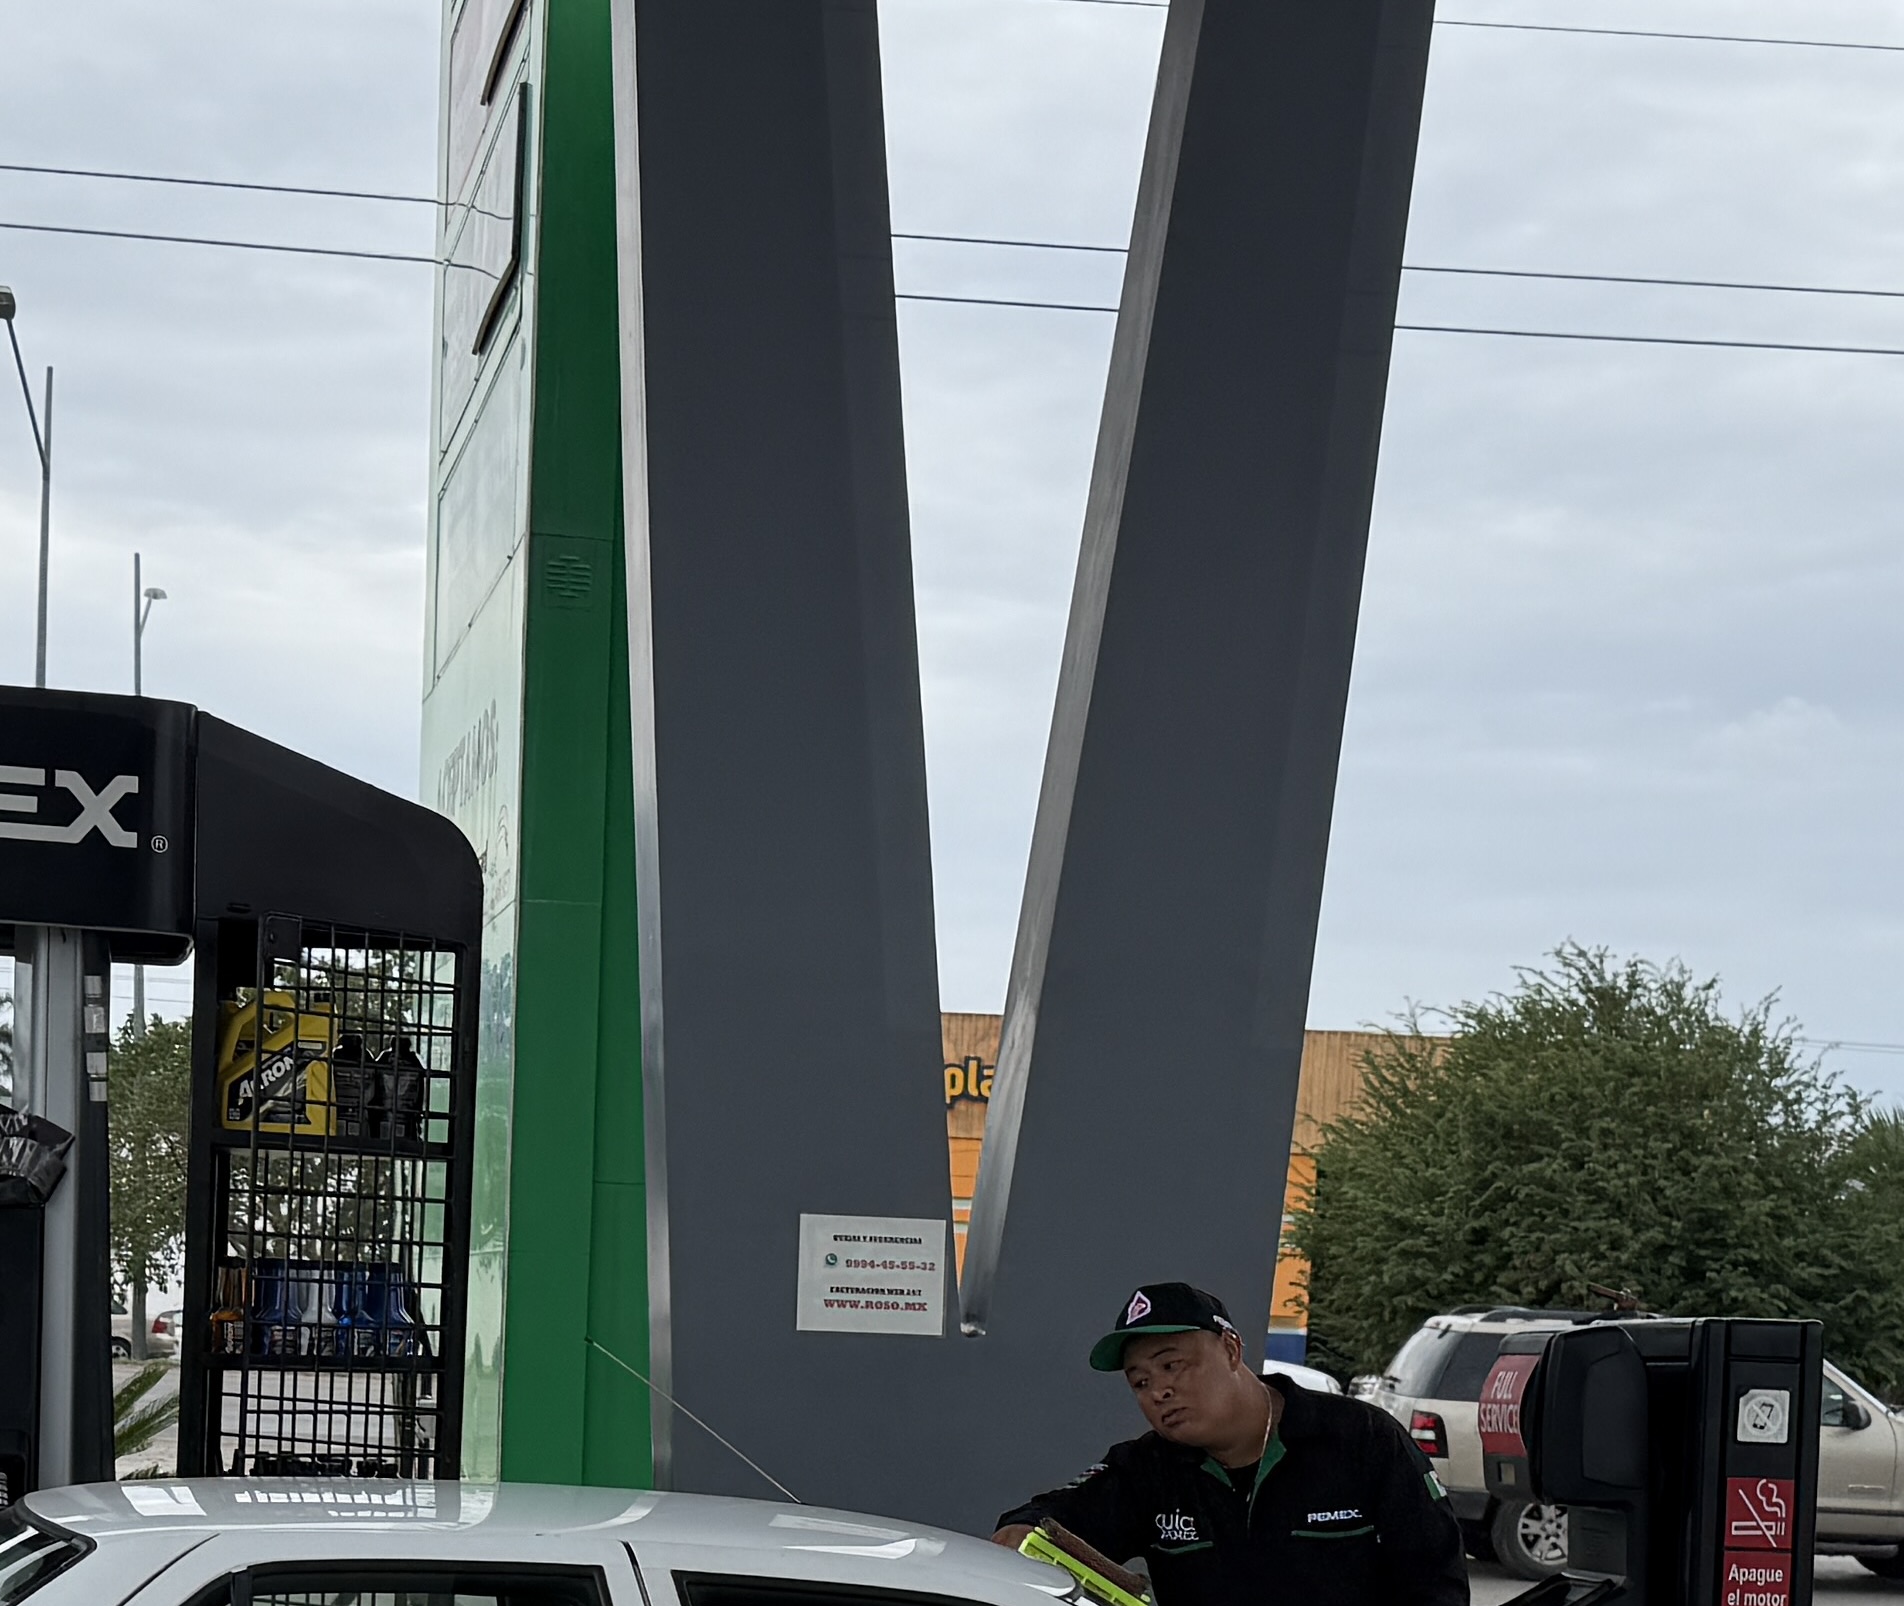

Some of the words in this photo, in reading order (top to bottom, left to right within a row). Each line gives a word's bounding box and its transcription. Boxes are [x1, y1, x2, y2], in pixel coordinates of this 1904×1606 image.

[1490, 1370, 1518, 1400] FULL
[1728, 1563, 1784, 1587] Apague
[1727, 1589, 1741, 1606] el
